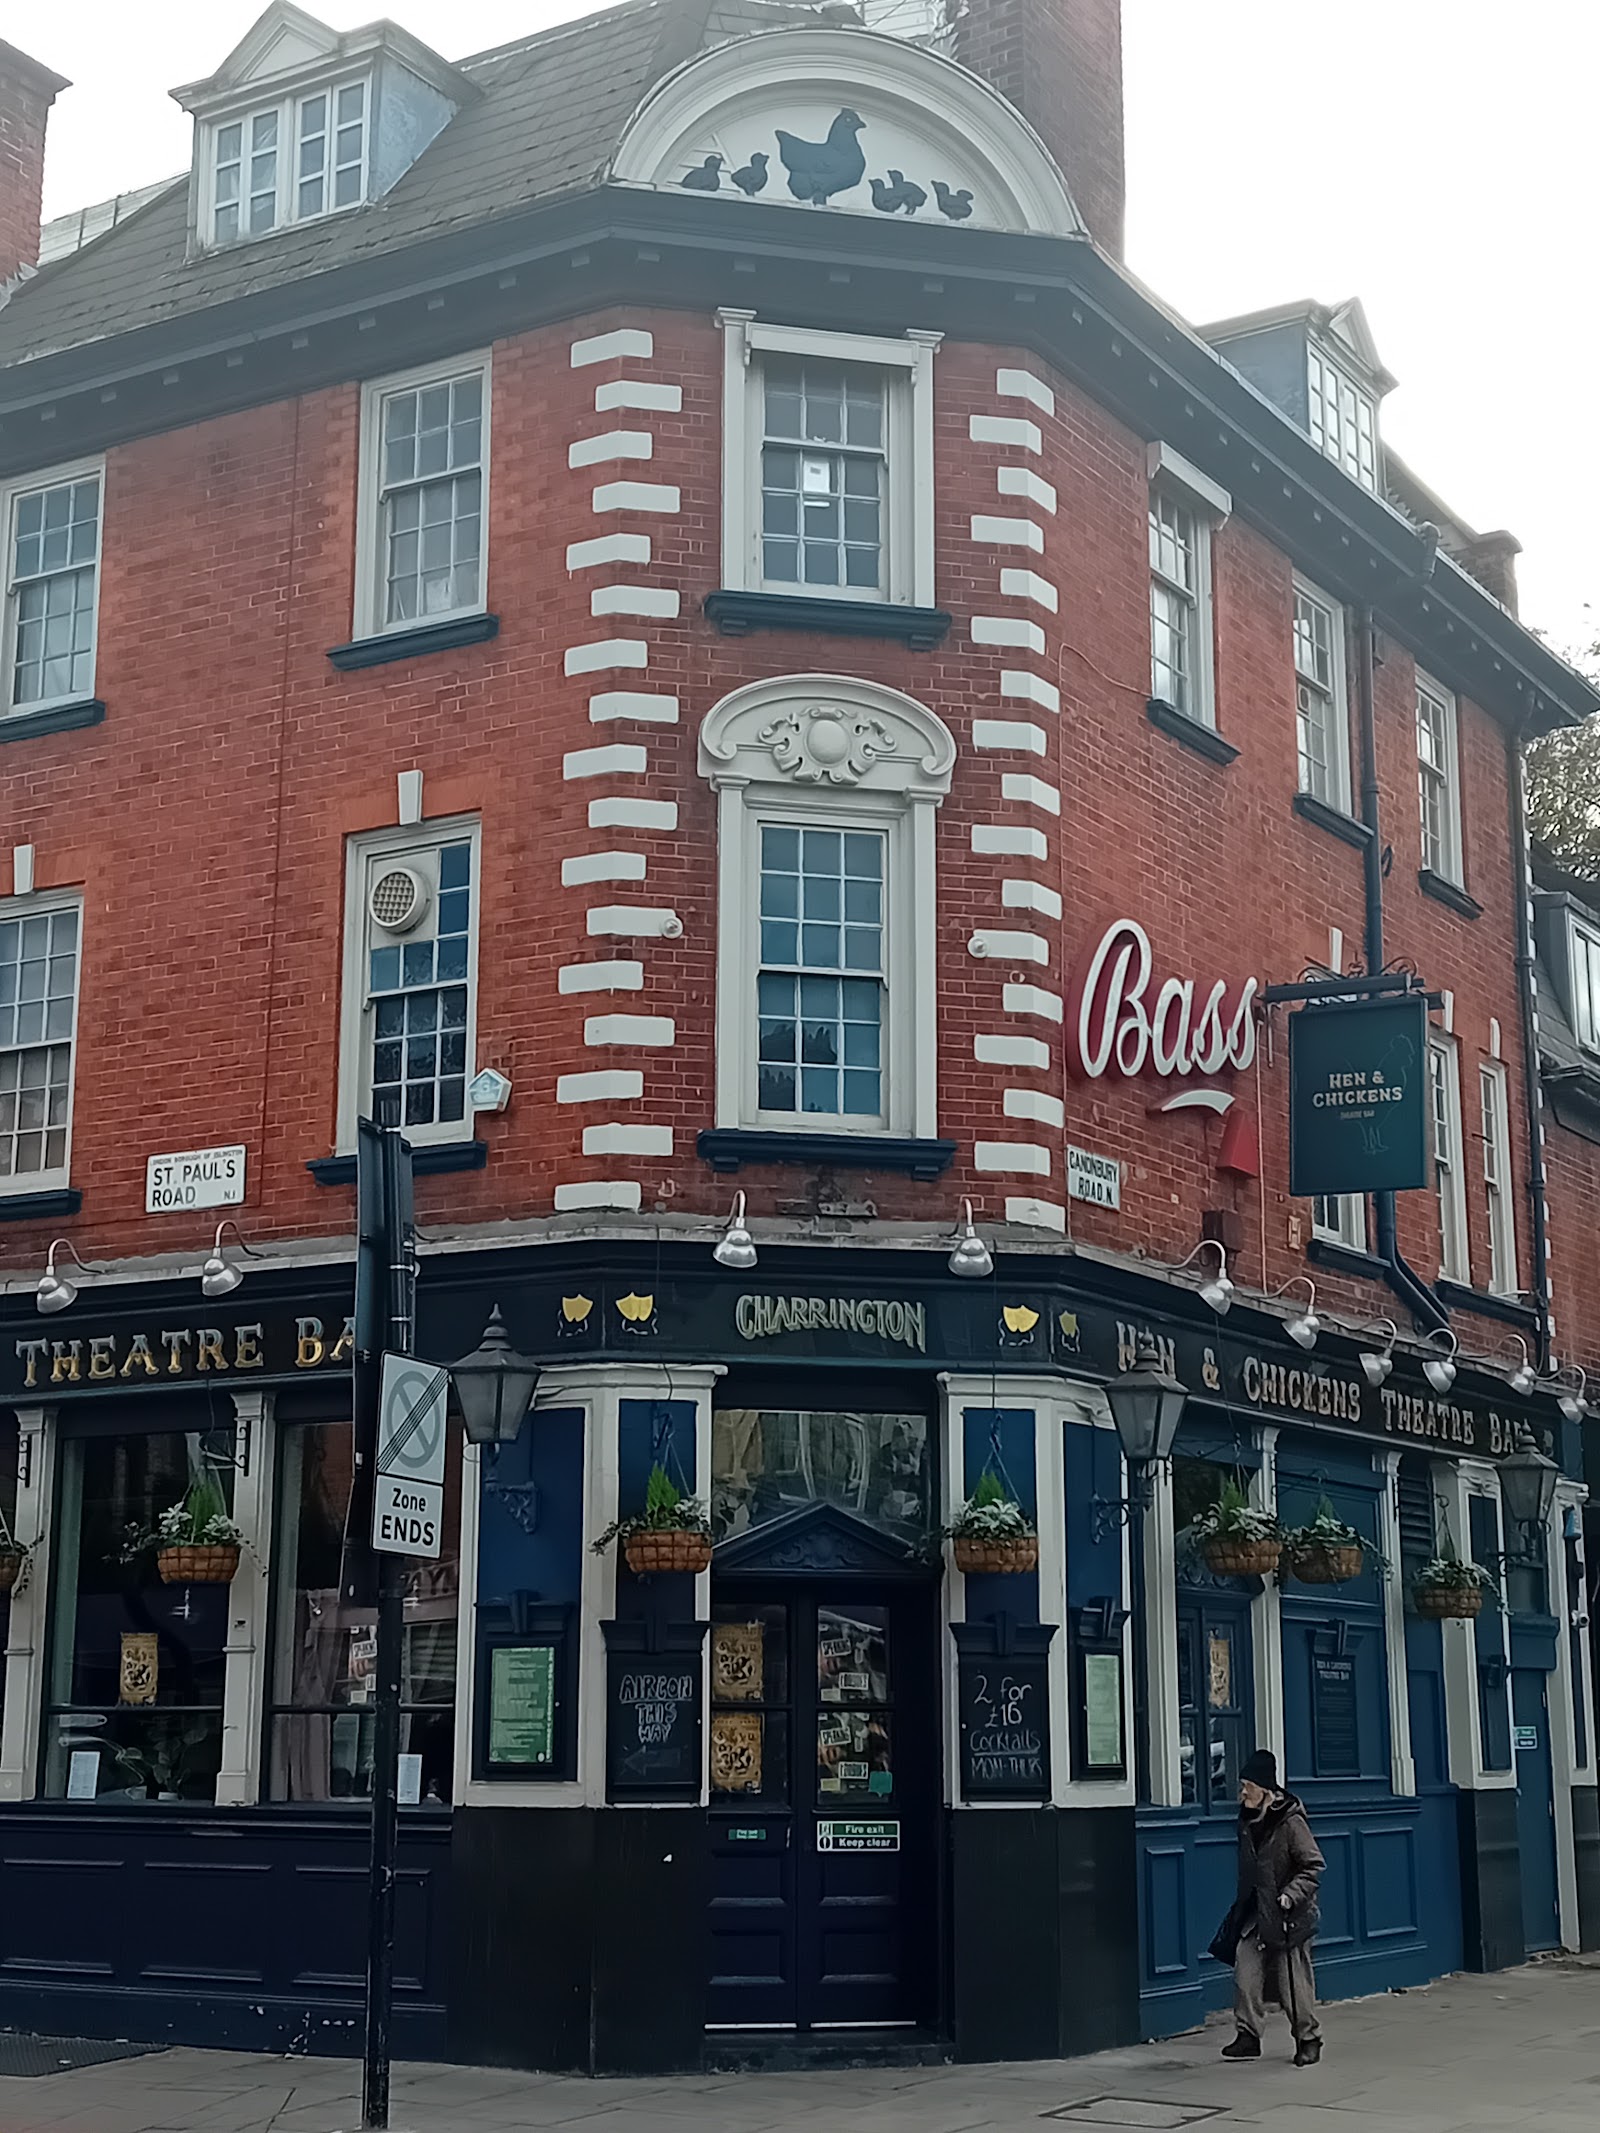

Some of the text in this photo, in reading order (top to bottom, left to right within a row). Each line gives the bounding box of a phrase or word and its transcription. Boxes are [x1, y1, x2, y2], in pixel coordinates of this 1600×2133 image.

[1079, 918, 1257, 1078] Bass
[1328, 1070, 1385, 1089] HEN &
[1312, 1086, 1403, 1108] CHICKENS
[183, 1159, 236, 1183] PAUL'S
[152, 1186, 196, 1207] ROAD
[736, 1294, 926, 1353] CHARRINGTON
[15, 1316, 356, 1388] THEATRE BA
[1115, 1320, 1176, 1380] HN
[1202, 1347, 1221, 1391] &
[1243, 1356, 1361, 1422] CHICKENS
[1380, 1387, 1475, 1445] THEATRE
[392, 1487, 426, 1512] Zone
[381, 1514, 434, 1546] ENDS
[619, 1674, 693, 1701] AIRCON
[974, 1675, 1032, 1704] 2 for
[634, 1702, 677, 1725] THIS
[985, 1701, 1023, 1728] £16
[638, 1723, 671, 1743] WAY
[845, 1824, 885, 1834] Fire exit
[838, 1837, 891, 1849] Keep clear
